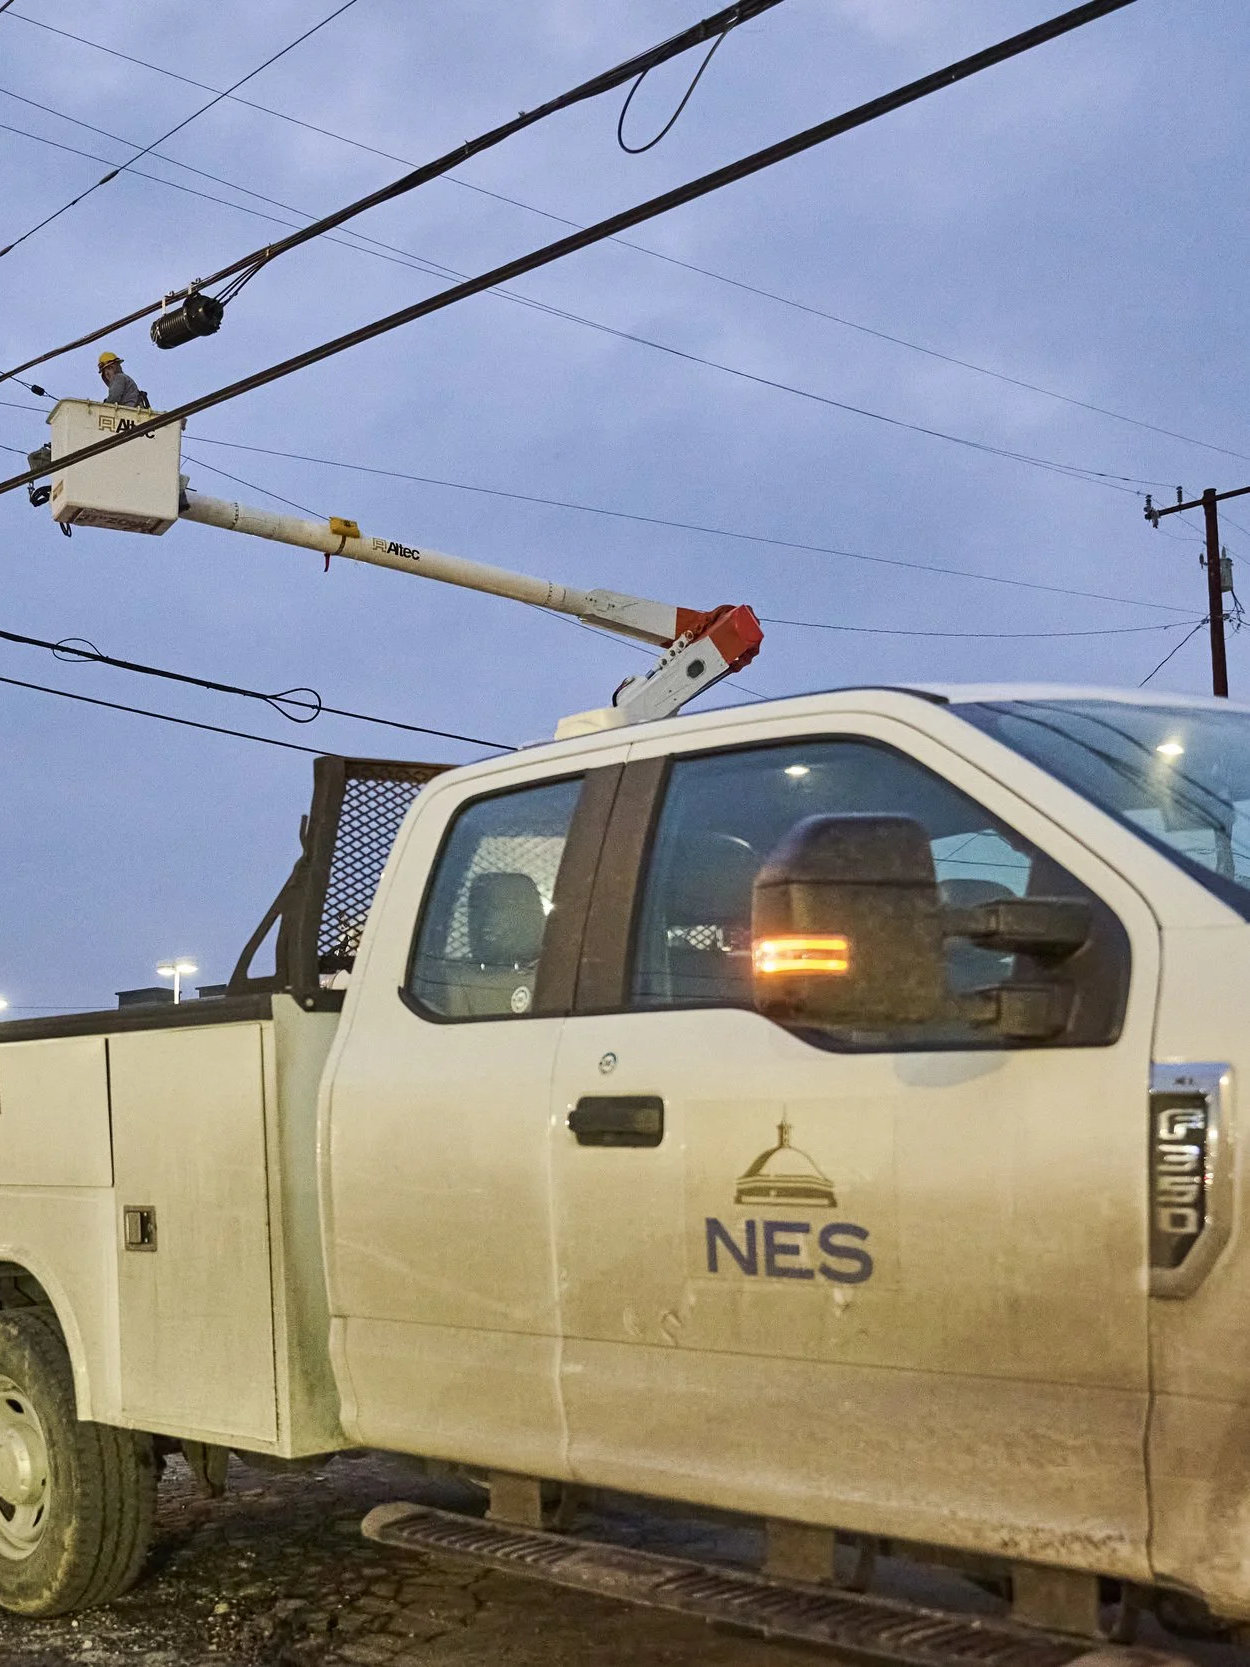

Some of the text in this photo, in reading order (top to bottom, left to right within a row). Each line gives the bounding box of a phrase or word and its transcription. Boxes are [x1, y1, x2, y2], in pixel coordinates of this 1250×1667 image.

[116, 418, 155, 439] Altc
[387, 541, 420, 561] Altec
[705, 1217, 874, 1285] NES
